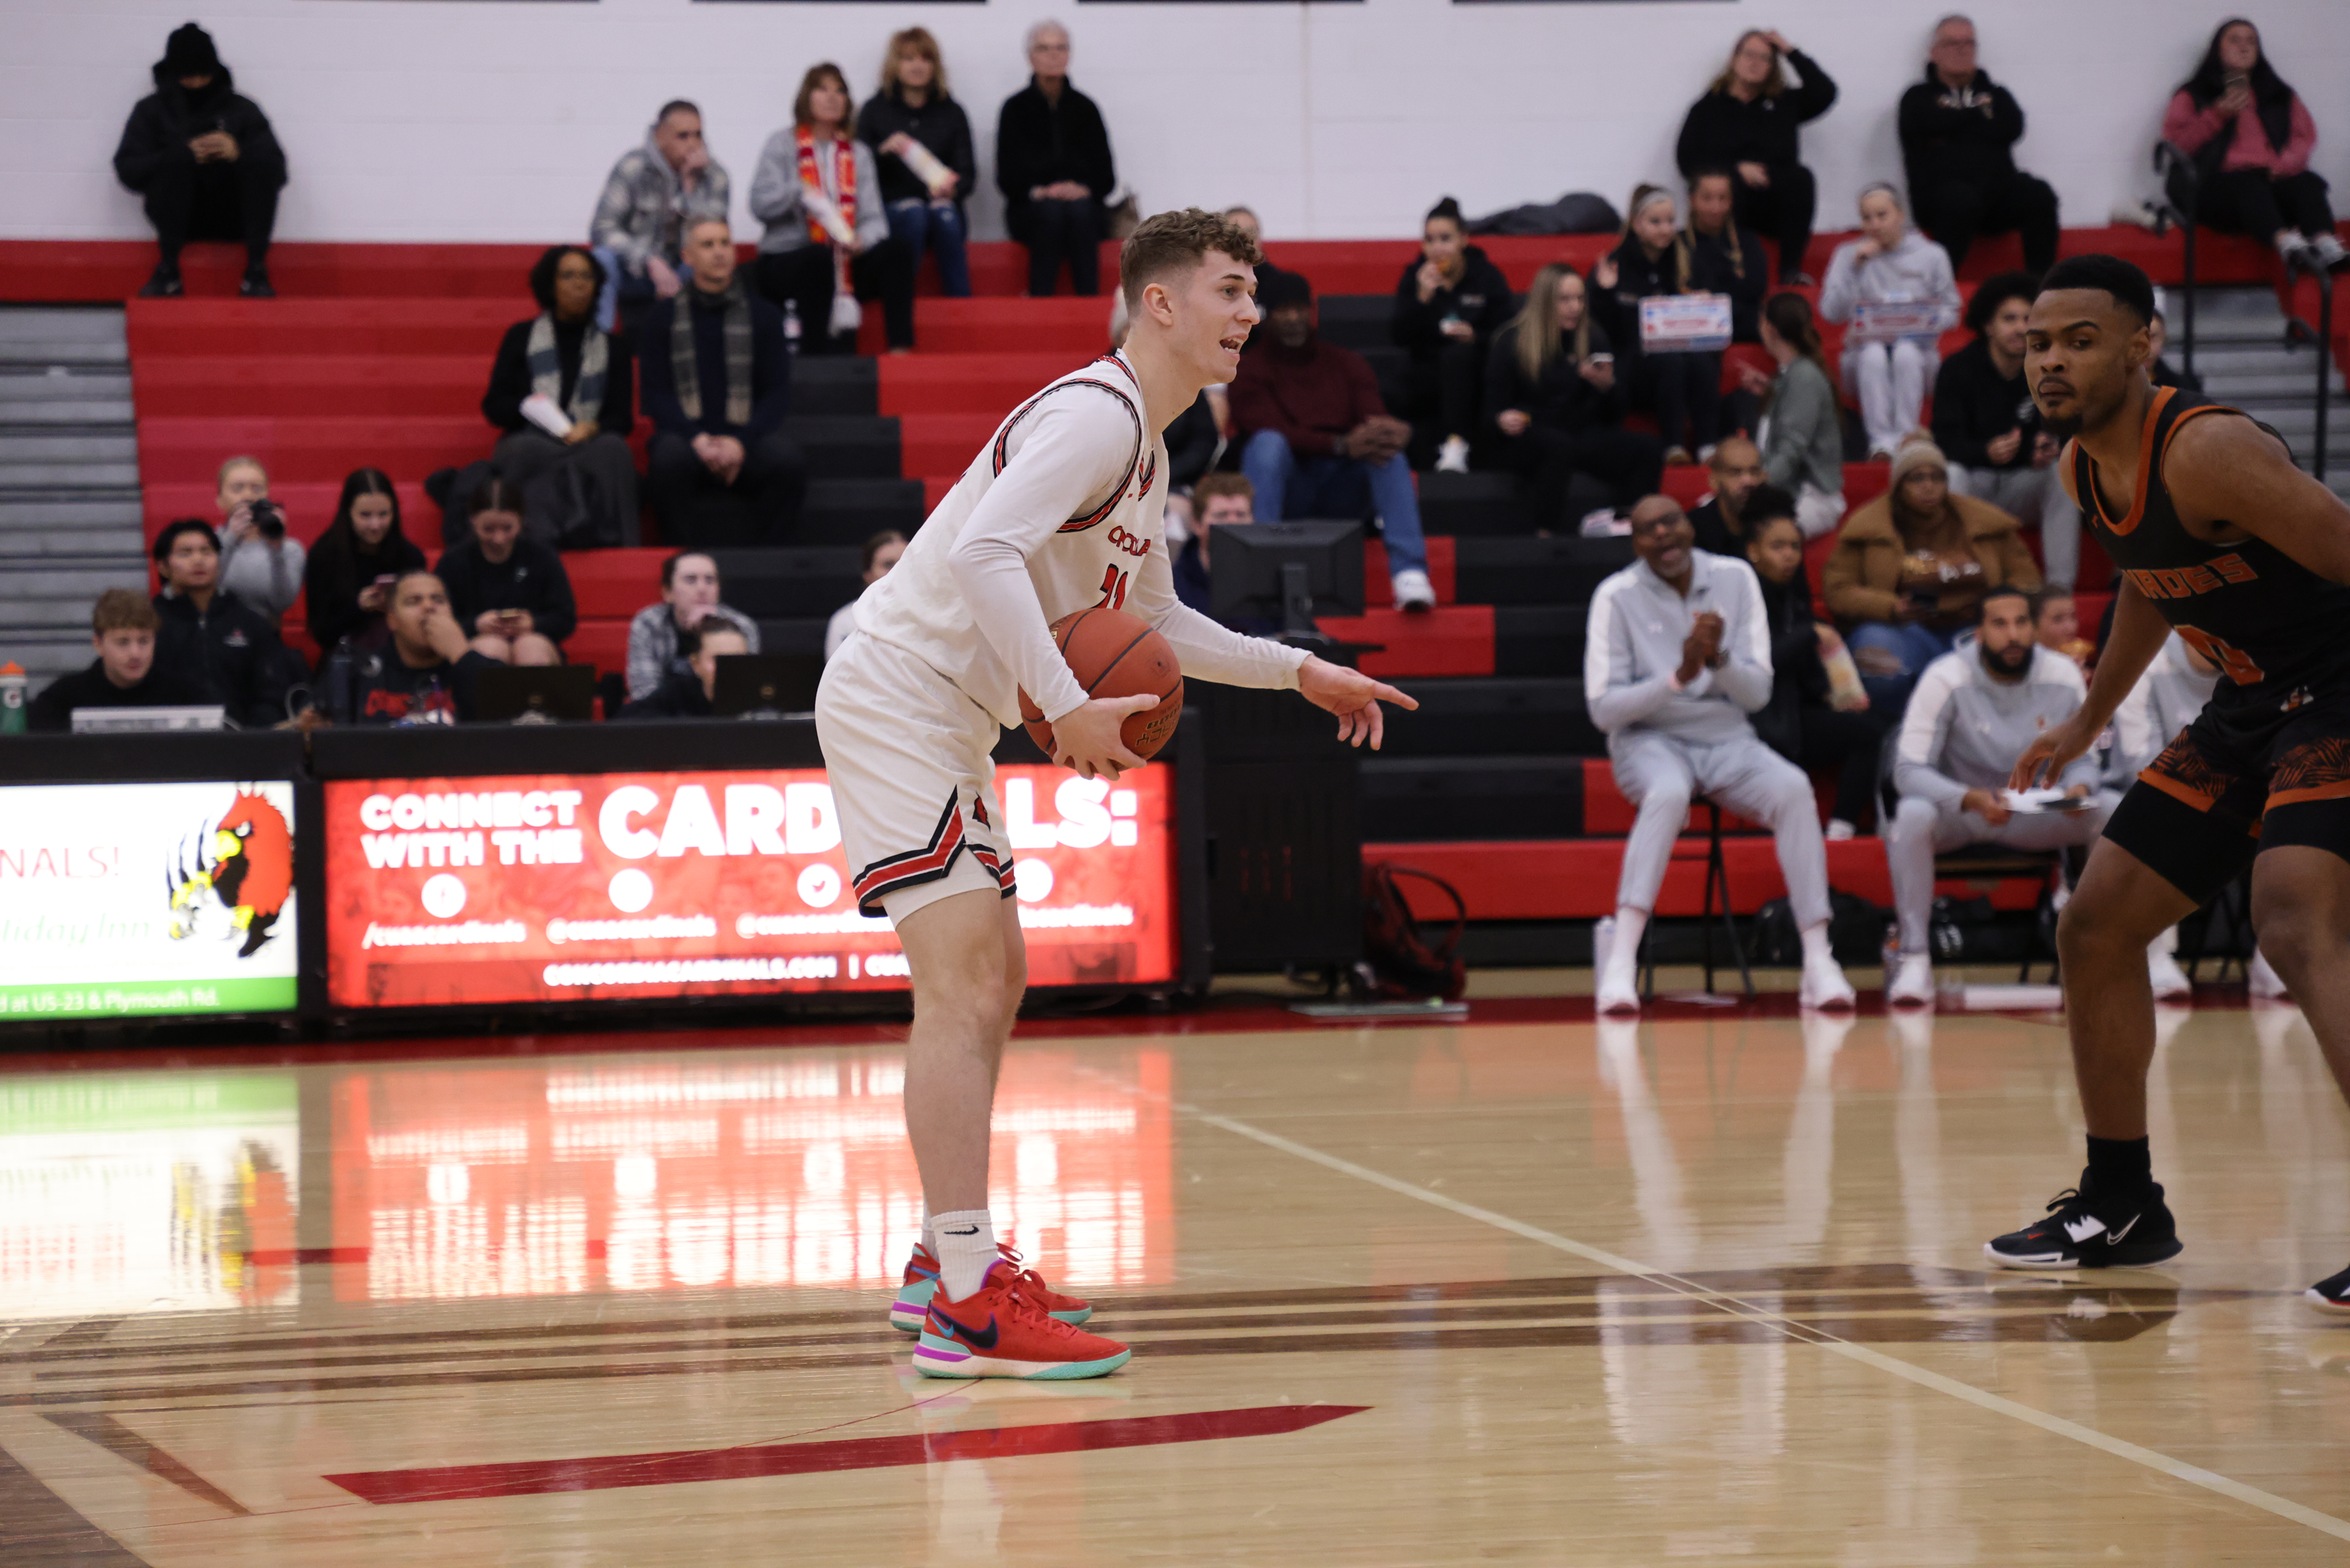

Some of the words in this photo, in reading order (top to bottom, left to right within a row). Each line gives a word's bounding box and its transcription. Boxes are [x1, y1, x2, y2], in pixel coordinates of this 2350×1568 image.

[2122, 553, 2258, 599] RDES
[360, 790, 582, 830] CONNECT
[360, 832, 484, 869] WITH
[491, 829, 583, 865] THE
[12, 996, 29, 1012] at
[33, 992, 84, 1012] US-23
[105, 989, 189, 1012] Plymouth
[192, 987, 220, 1006] Rd.
